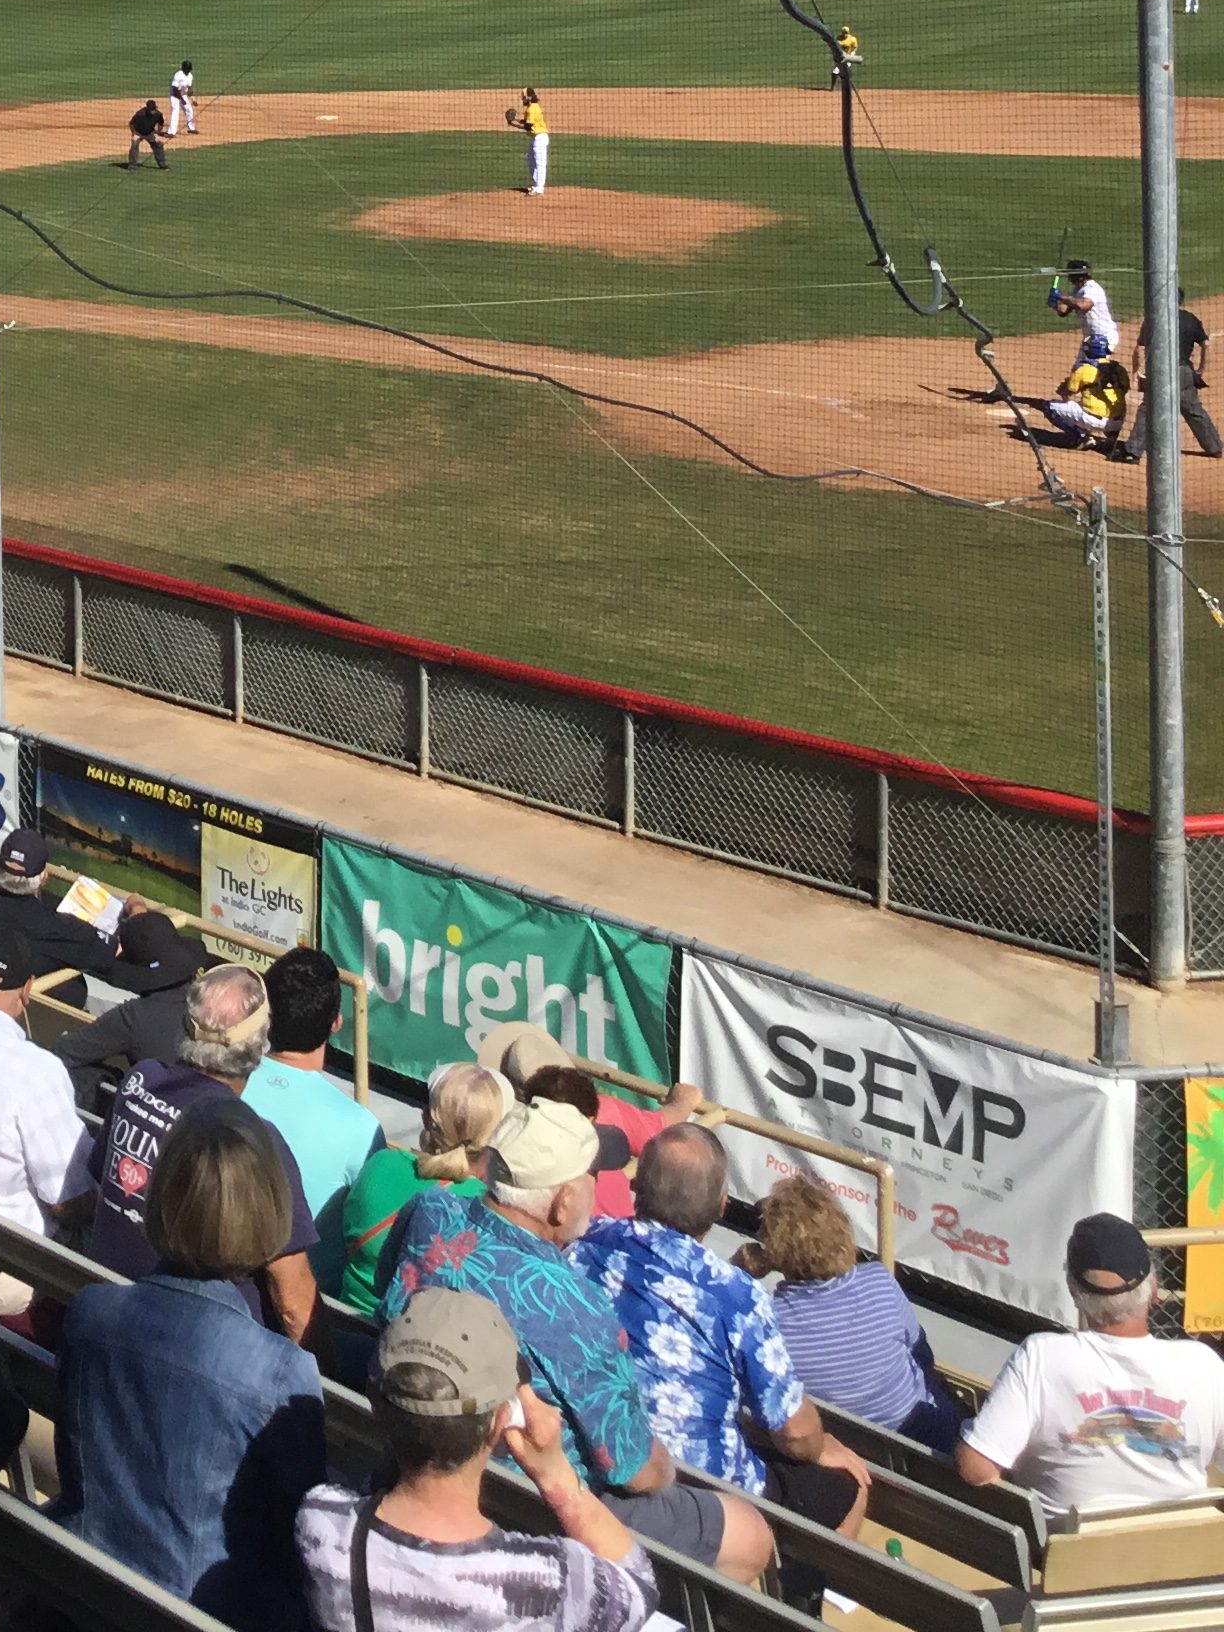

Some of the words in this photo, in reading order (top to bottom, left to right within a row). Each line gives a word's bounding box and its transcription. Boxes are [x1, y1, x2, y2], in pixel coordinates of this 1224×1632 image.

[87, 764, 125, 788] RATES
[128, 778, 164, 801] FROM
[167, 789, 191, 810] $20
[202, 801, 218, 818] 18
[220, 807, 263, 834] HOLES
[231, 896, 250, 912] Indio
[252, 903, 266, 916] GC
[233, 920, 288, 945] IndioGolf.com
[362, 899, 618, 1070] bright
[765, 1024, 1026, 1164] SBEMP
[123, 1163, 144, 1185] 50+
